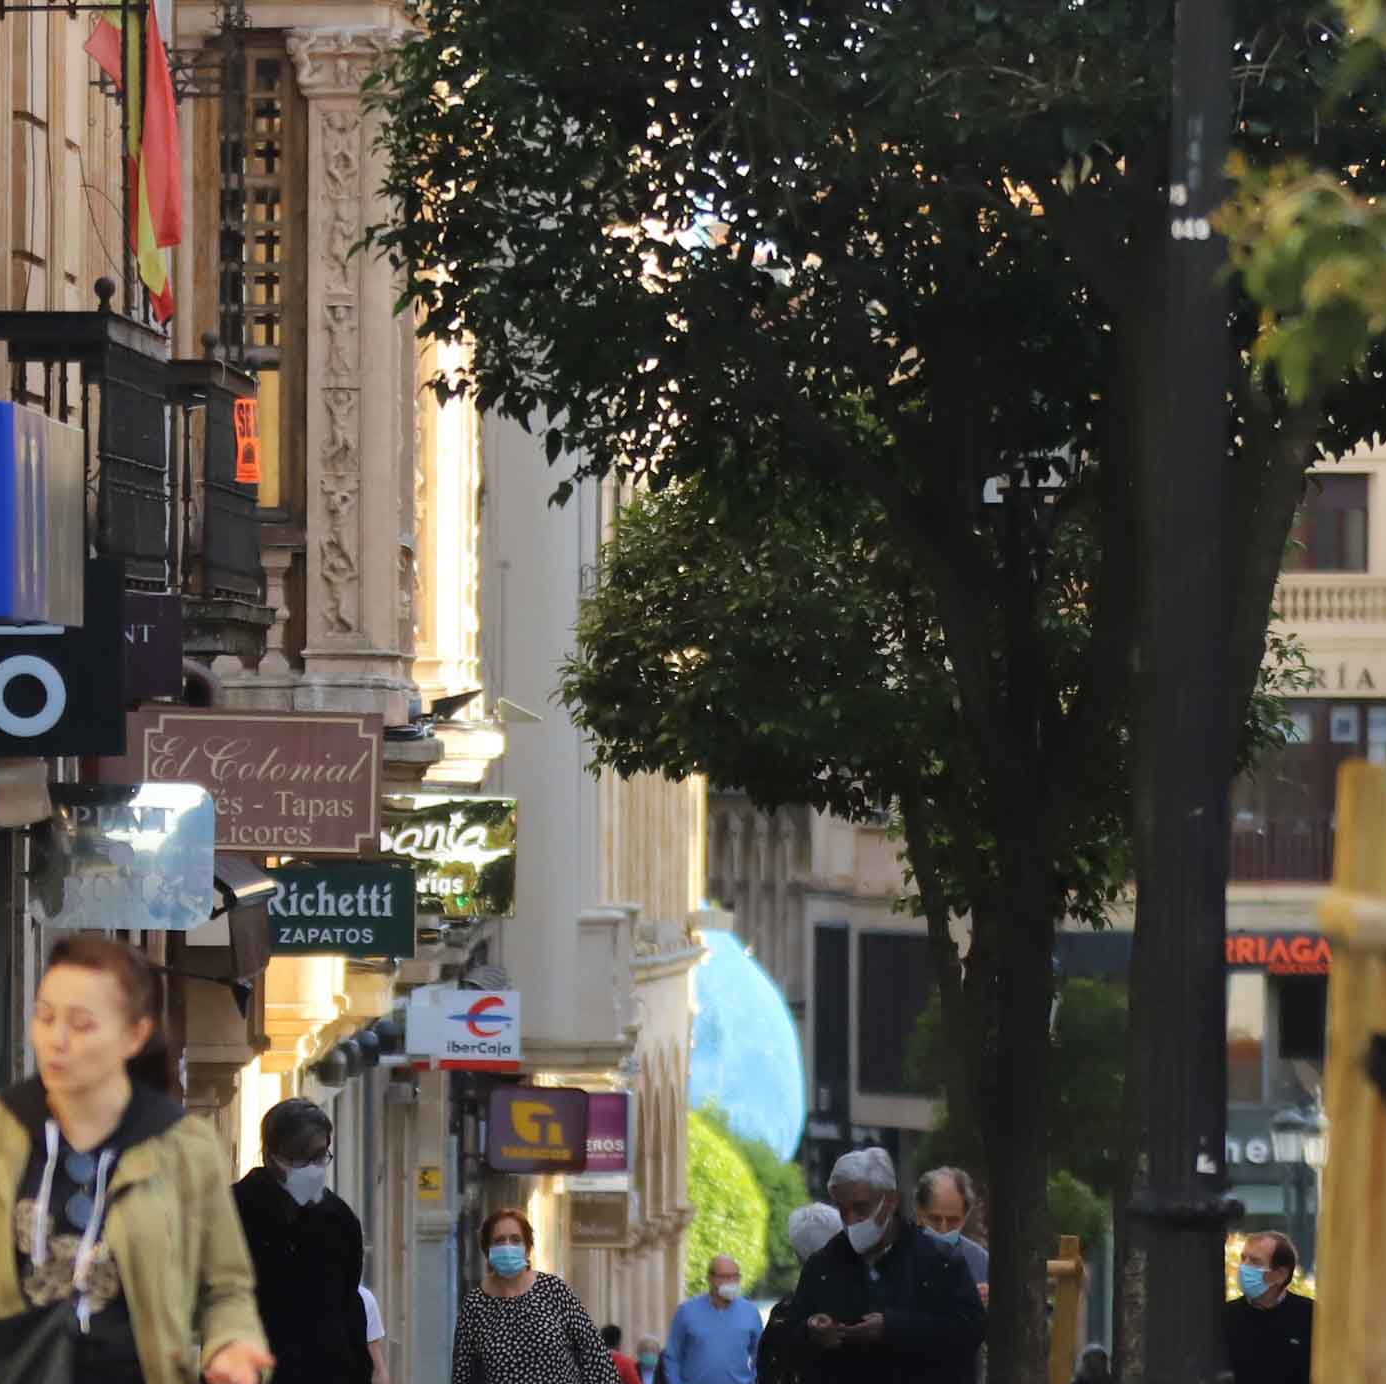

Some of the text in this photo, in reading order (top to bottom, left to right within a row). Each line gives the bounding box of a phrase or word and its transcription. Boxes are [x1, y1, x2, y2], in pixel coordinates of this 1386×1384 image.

[150, 736, 371, 784] El Colonial
[213, 787, 244, 815] és
[274, 791, 354, 824] Tapas
[267, 880, 393, 918] Richetti
[278, 928, 374, 944] ZAPATOS
[446, 1040, 512, 1057] iberCaja
